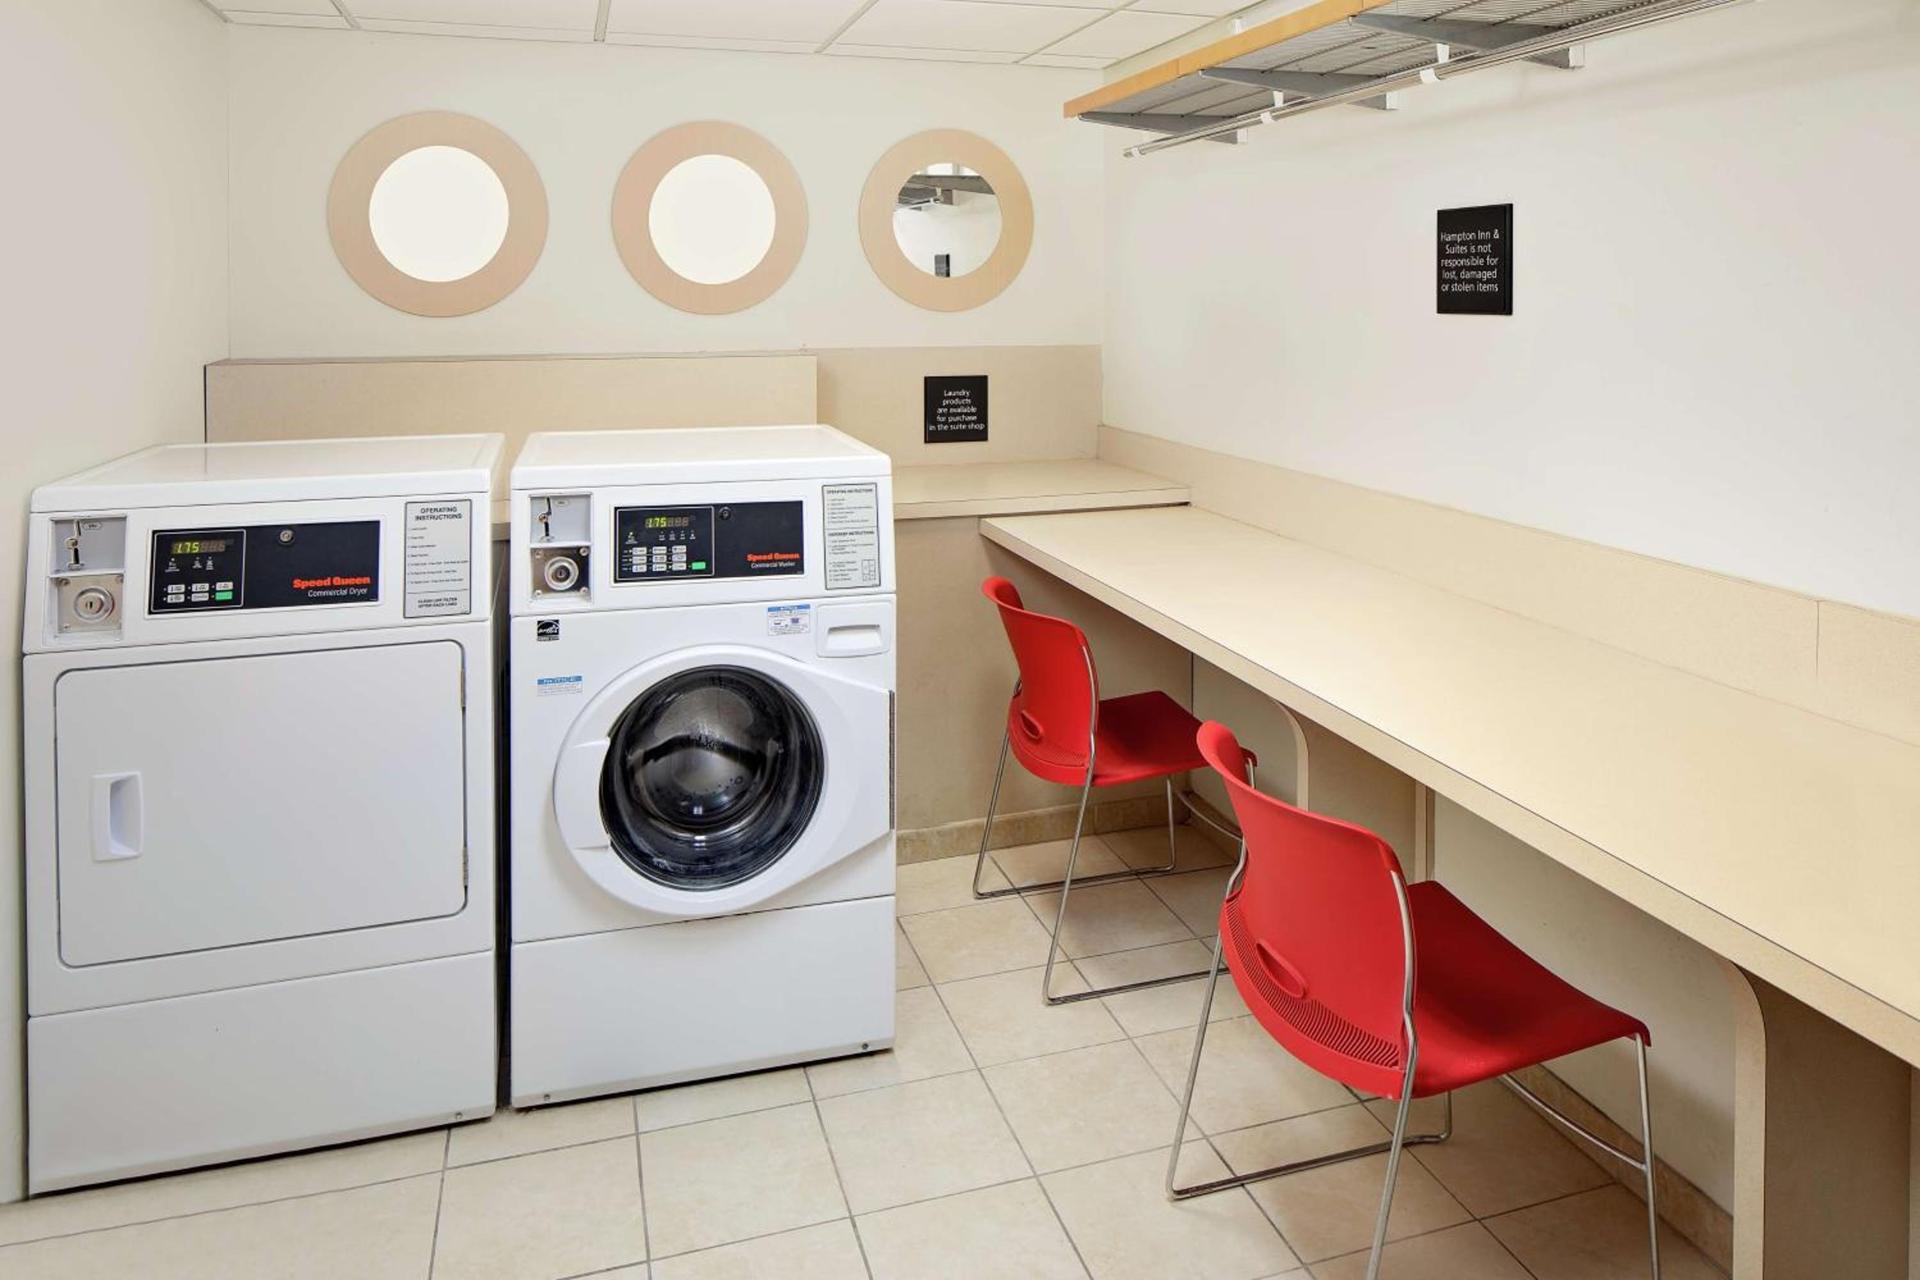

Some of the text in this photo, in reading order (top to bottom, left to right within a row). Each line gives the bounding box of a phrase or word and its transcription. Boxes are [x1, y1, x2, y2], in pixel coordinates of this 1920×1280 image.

[1440, 228, 1499, 243] Hampton Inn &
[1445, 243, 1492, 254] Suites is not
[1440, 255, 1499, 268] responsible for
[1442, 268, 1497, 281] lost, damaged
[1441, 281, 1499, 292] or stolen items
[943, 389, 970, 397] Laundry
[942, 398, 971, 406] products
[968, 423, 985, 431] shop
[747, 552, 773, 562] Speed
[293, 576, 370, 589] Speed Queen
[308, 587, 368, 598] Commercial Dryer
